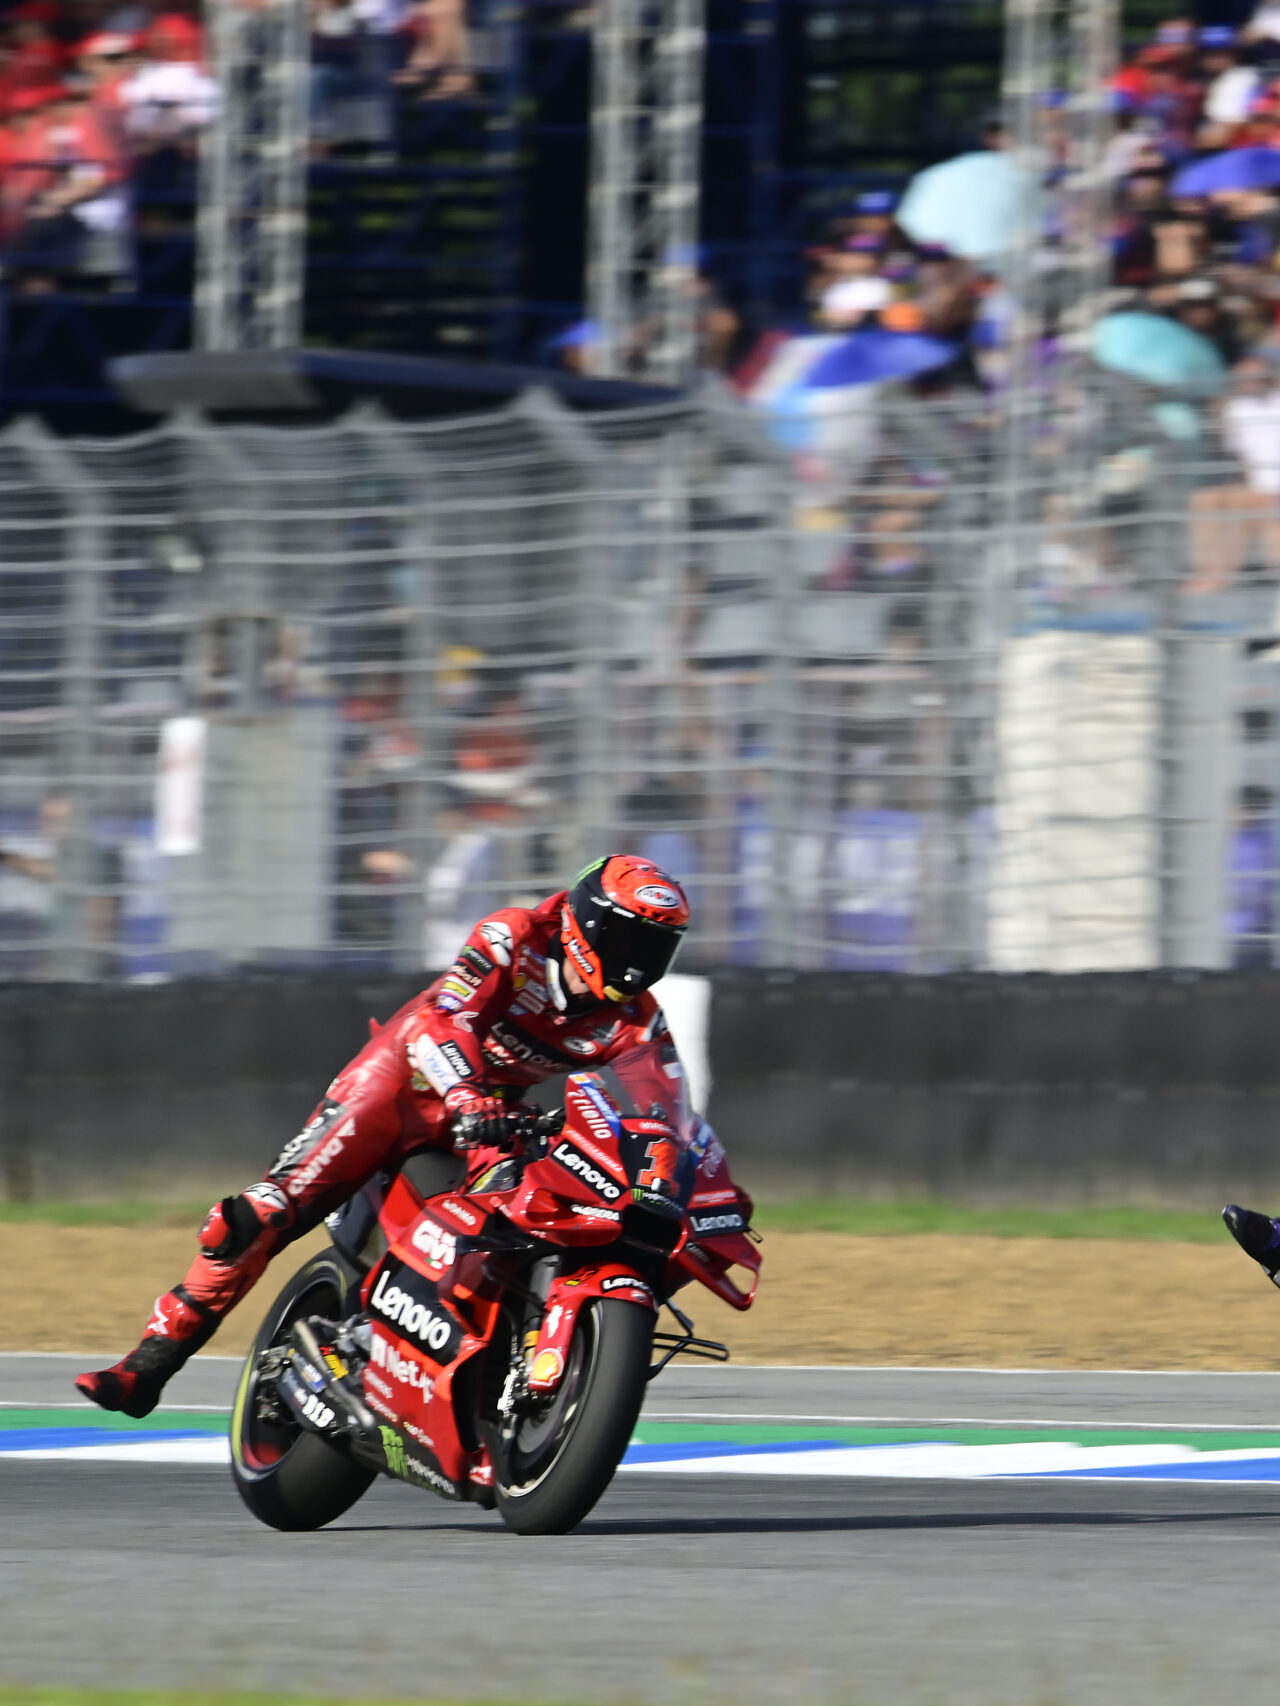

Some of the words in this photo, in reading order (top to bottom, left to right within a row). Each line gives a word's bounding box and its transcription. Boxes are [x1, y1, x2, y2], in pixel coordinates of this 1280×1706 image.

[440, 1042, 472, 1077] Lenovo
[552, 1143, 620, 1199] Lenovo
[635, 1137, 681, 1196] 1
[689, 1212, 743, 1232] Lenovo
[371, 1270, 451, 1350] Lenovo
